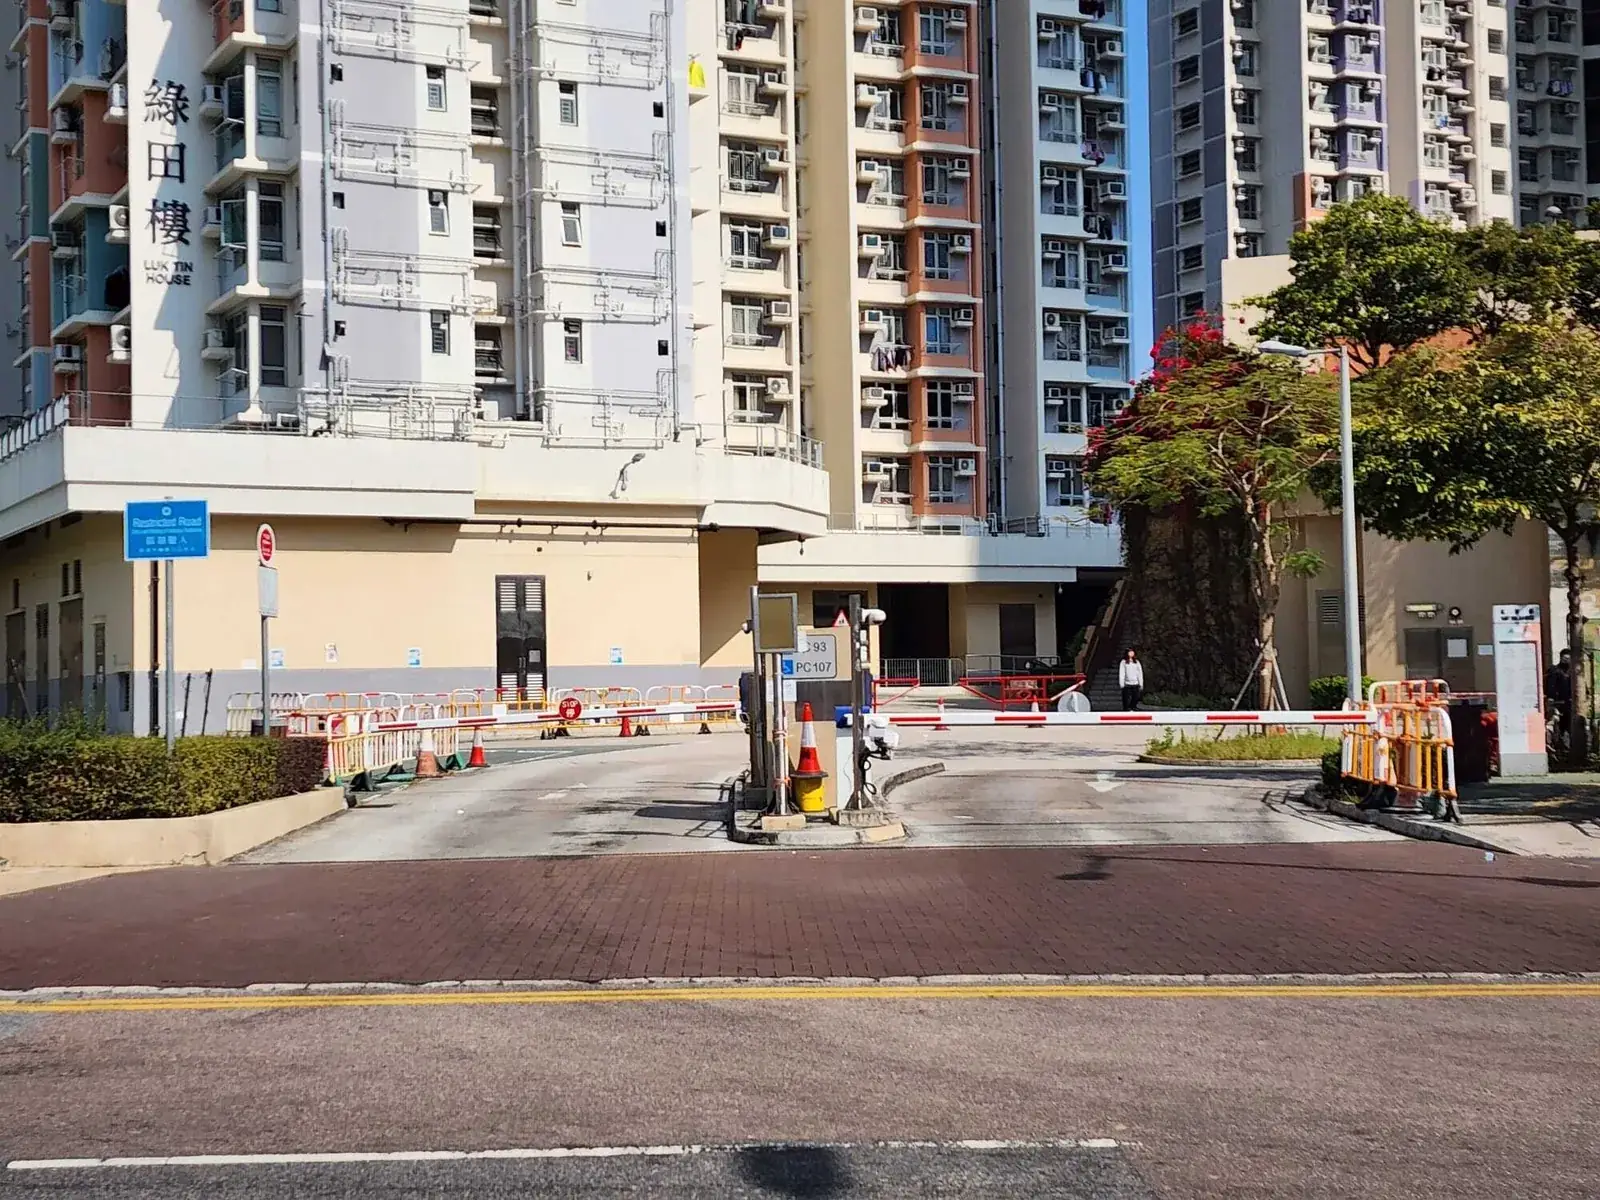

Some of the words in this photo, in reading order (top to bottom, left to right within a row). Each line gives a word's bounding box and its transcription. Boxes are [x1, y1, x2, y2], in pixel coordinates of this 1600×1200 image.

[144, 79, 191, 246] 綠田樓
[143, 260, 169, 272] LUK
[173, 262, 194, 273] TIN
[146, 273, 192, 286] HOUSE
[562, 700, 579, 708] STOP
